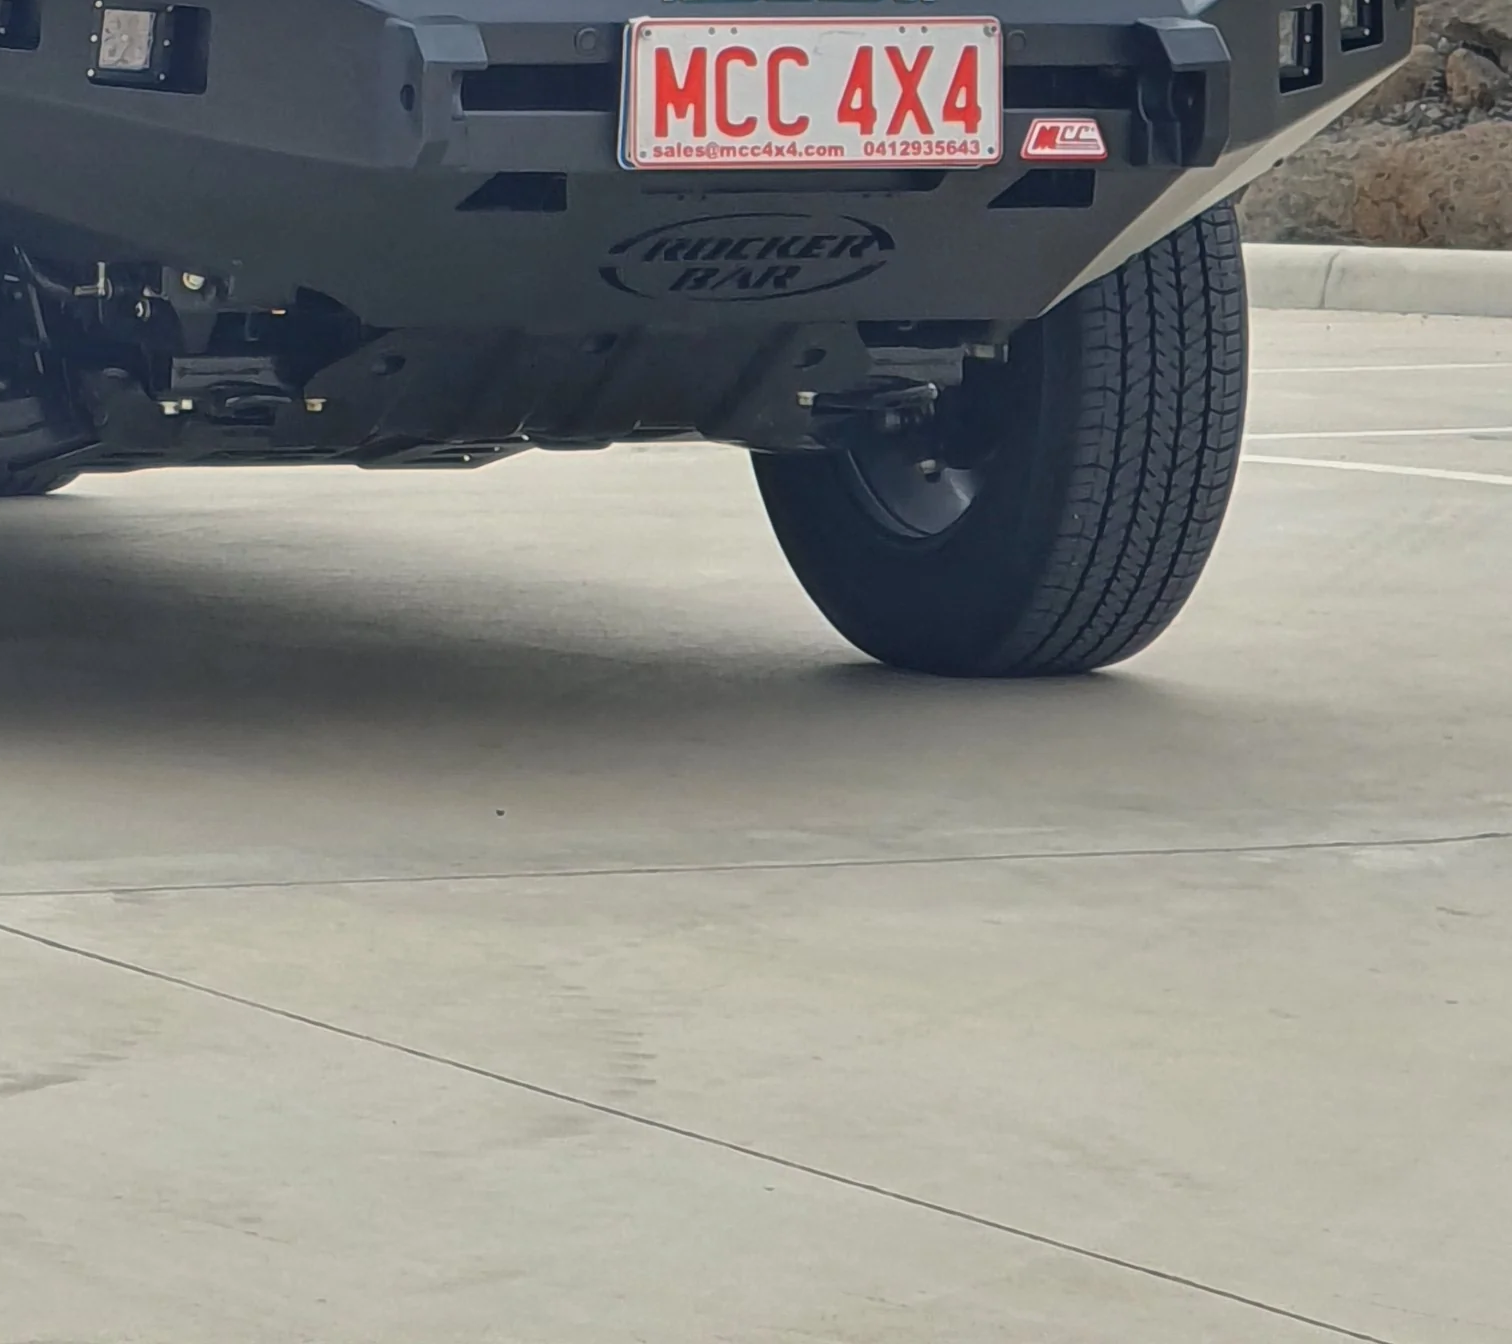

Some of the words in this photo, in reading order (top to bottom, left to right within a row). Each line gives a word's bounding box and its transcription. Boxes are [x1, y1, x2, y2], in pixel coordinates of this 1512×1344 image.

[653, 46, 810, 139] MCC
[836, 45, 983, 136] 4X4
[652, 141, 846, 160] sales@mcc4x4.com
[863, 140, 981, 157] 0412935643
[642, 235, 879, 262] ROCKER
[668, 265, 802, 292] BAR
